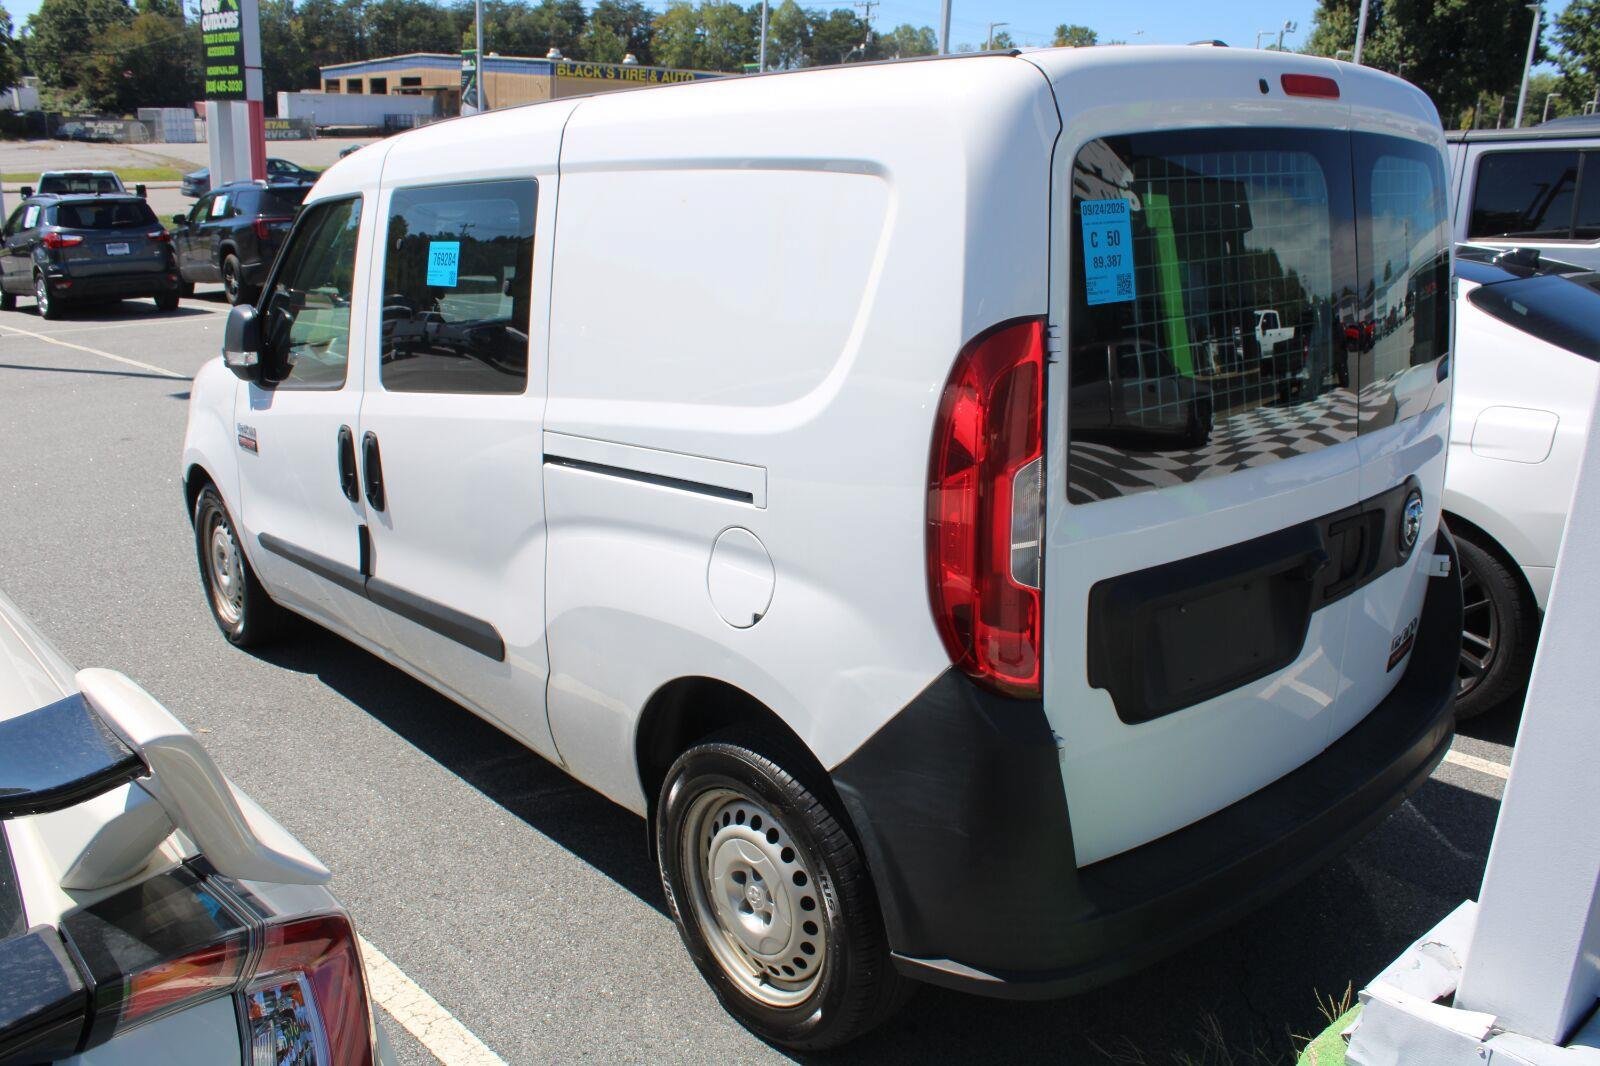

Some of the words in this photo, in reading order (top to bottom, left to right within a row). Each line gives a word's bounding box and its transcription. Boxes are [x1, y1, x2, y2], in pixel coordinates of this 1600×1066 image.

[557, 64, 615, 79] BLACK'S
[618, 68, 646, 82] TIRE
[649, 72, 658, 83] &
[661, 73, 695, 83] AUTO
[264, 130, 301, 138] RVICES
[1082, 203, 1124, 215] 09/24/2026
[1091, 232, 1099, 248] C
[1107, 231, 1121, 247] 50
[433, 252, 456, 266] 769284
[1093, 254, 1122, 270] 89,387
